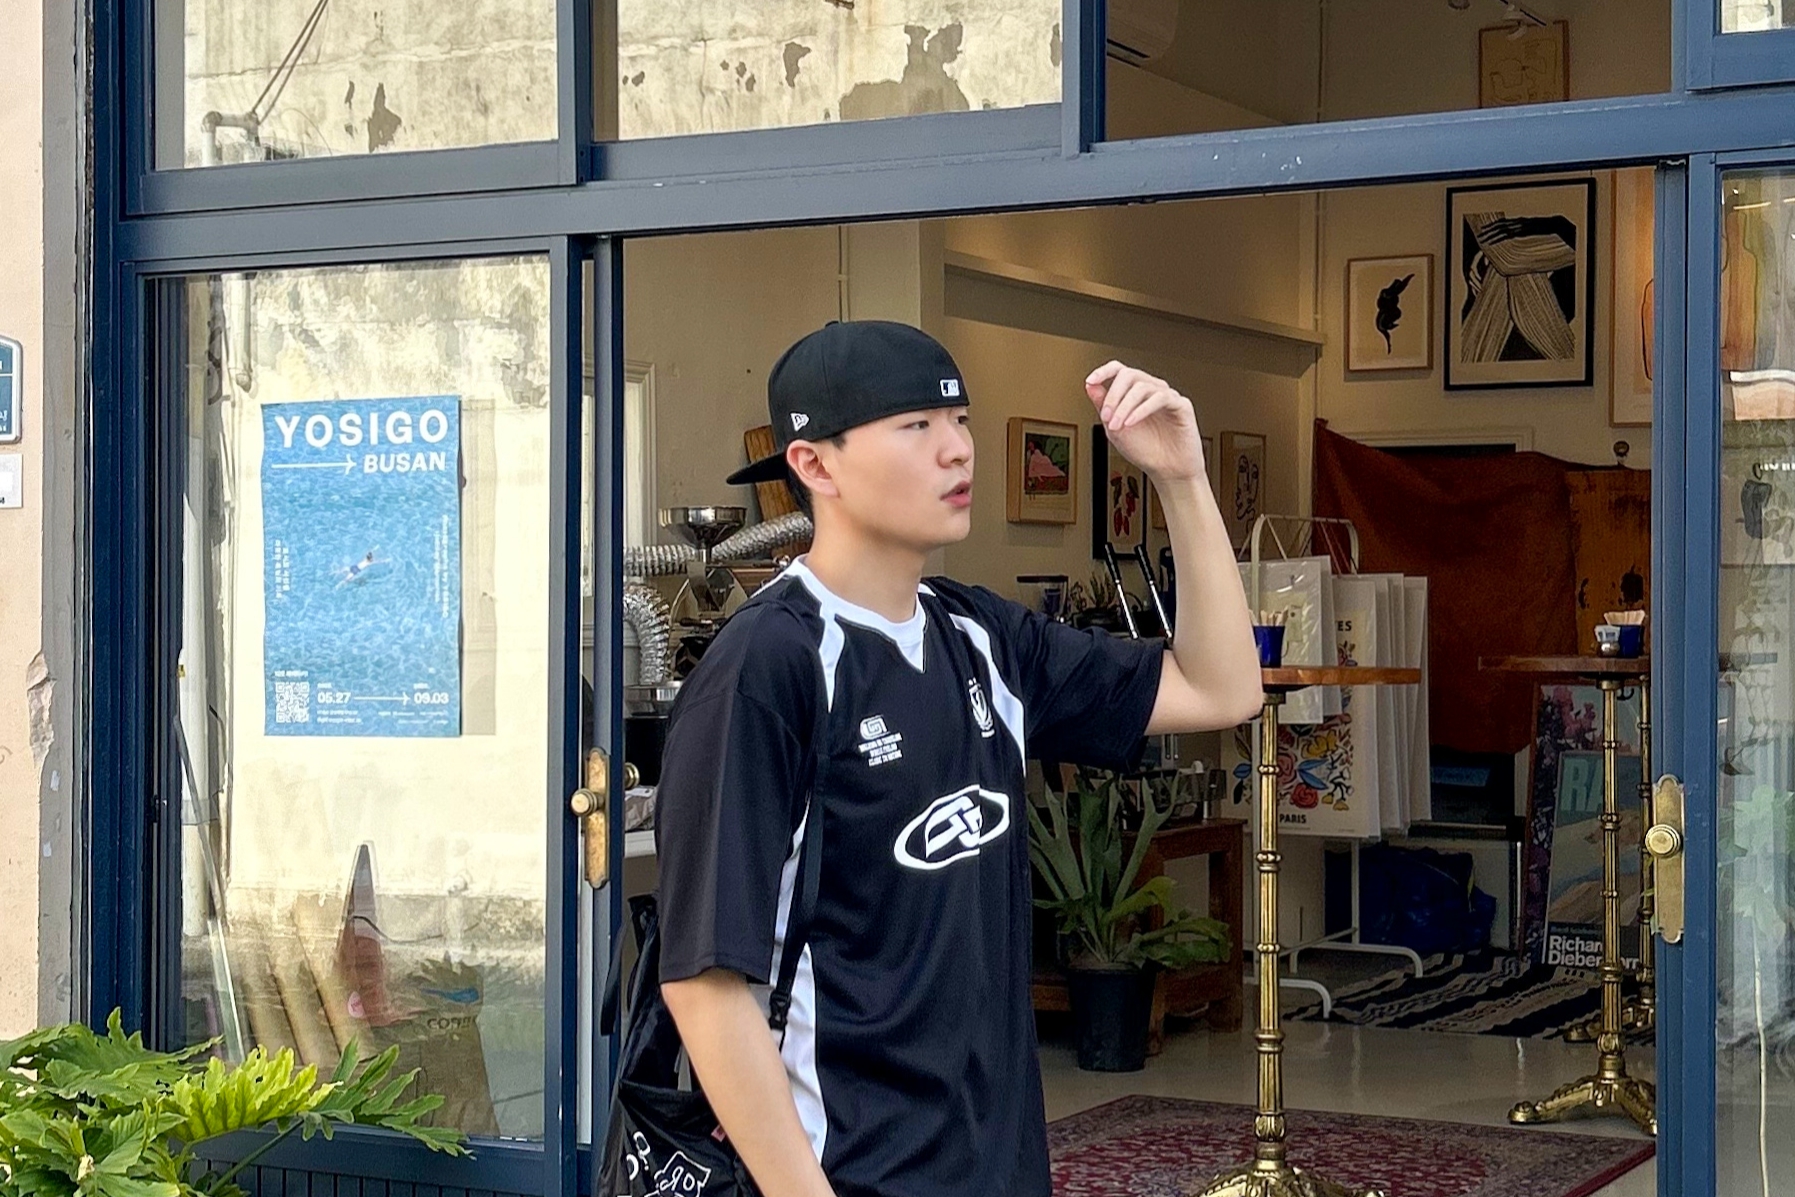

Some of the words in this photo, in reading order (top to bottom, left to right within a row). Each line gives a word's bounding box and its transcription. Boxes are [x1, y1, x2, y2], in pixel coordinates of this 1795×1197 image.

[274, 409, 449, 448] YOSIGO
[363, 451, 446, 473] BUSAN
[1335, 620, 1352, 631] ES
[317, 691, 351, 704] 05.27
[413, 692, 449, 704] 09.03
[1279, 813, 1307, 824] PARIS
[1549, 935, 1604, 953] Richar
